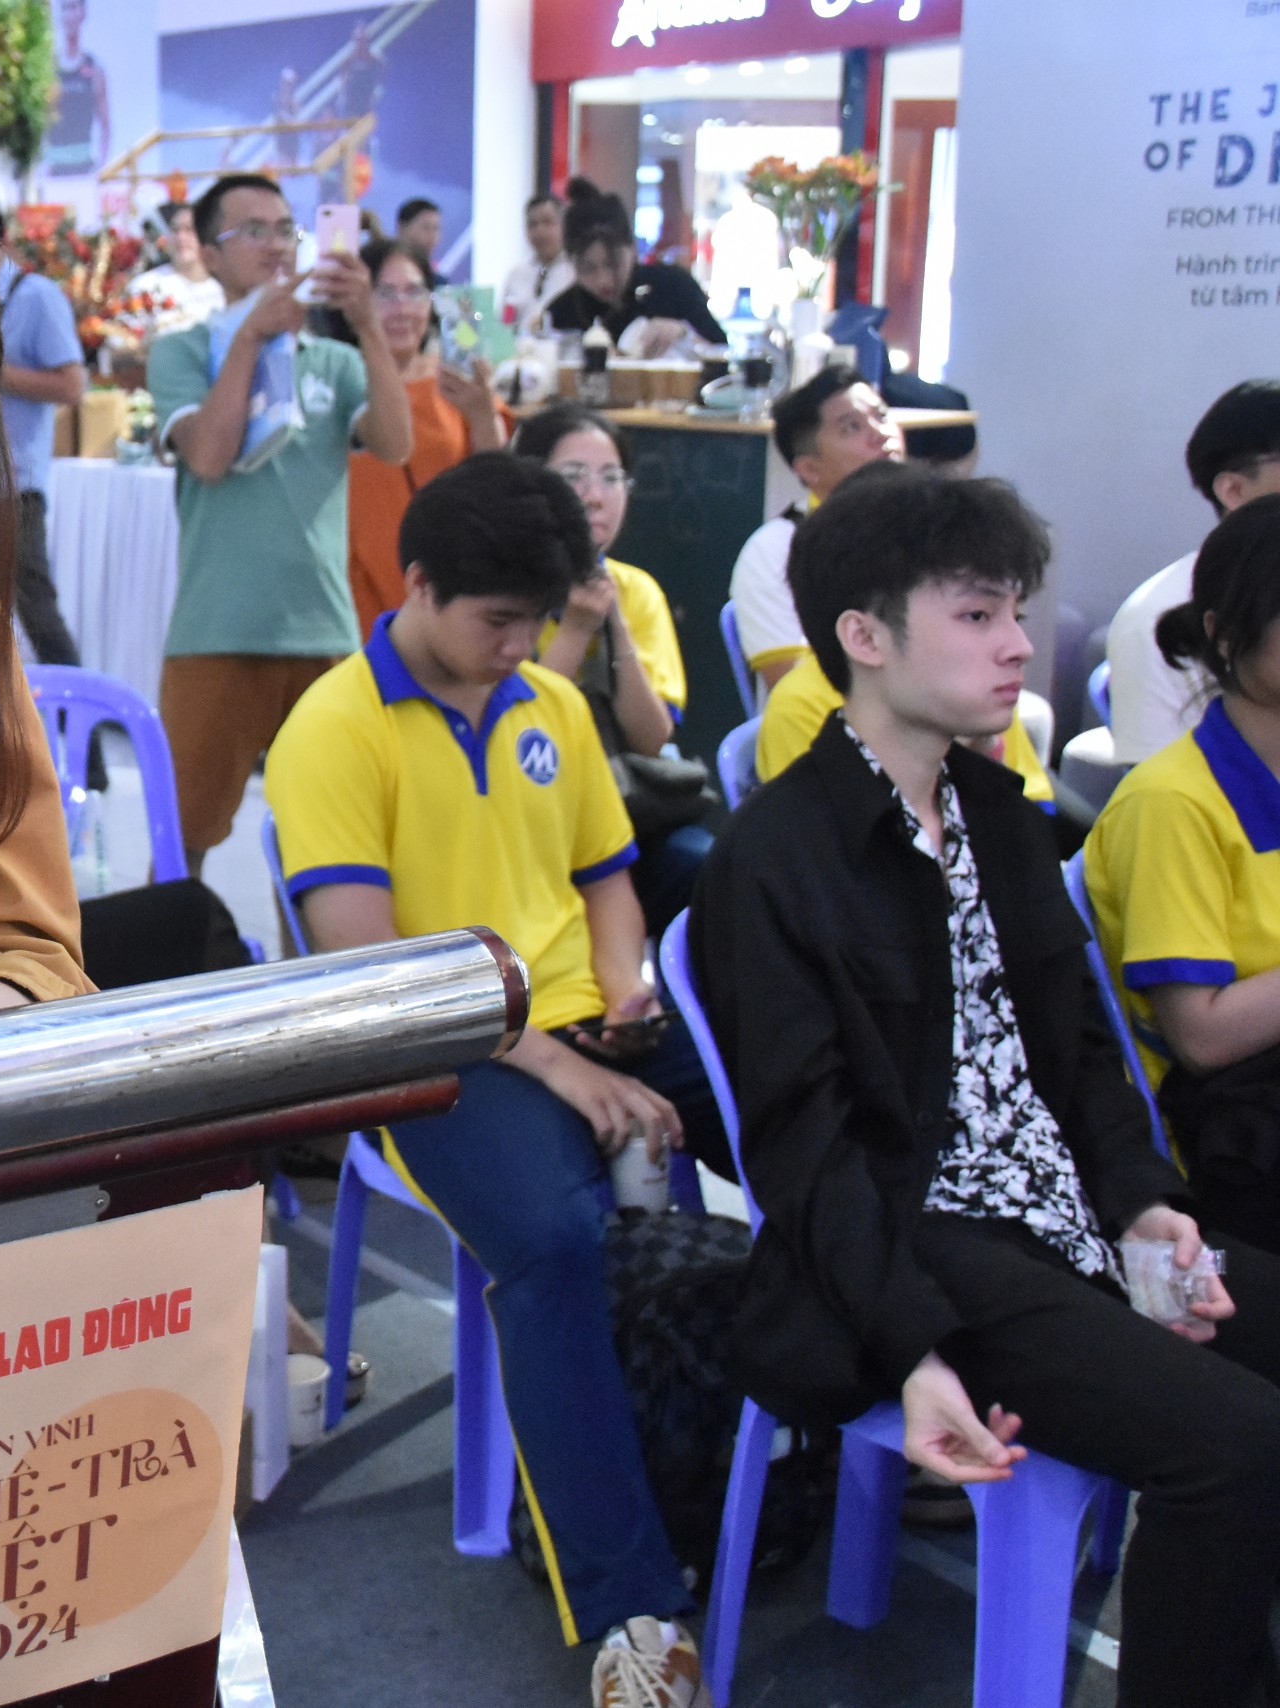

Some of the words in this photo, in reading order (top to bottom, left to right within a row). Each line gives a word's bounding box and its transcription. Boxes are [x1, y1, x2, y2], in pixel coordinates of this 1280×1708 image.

[1149, 87, 1231, 126] THE
[1144, 138, 1197, 172] OF
[1166, 206, 1237, 229] FROM
[1243, 203, 1280, 226] TH
[82, 1287, 192, 1356] ĐỘNG
[24, 1413, 95, 1450] VINH
